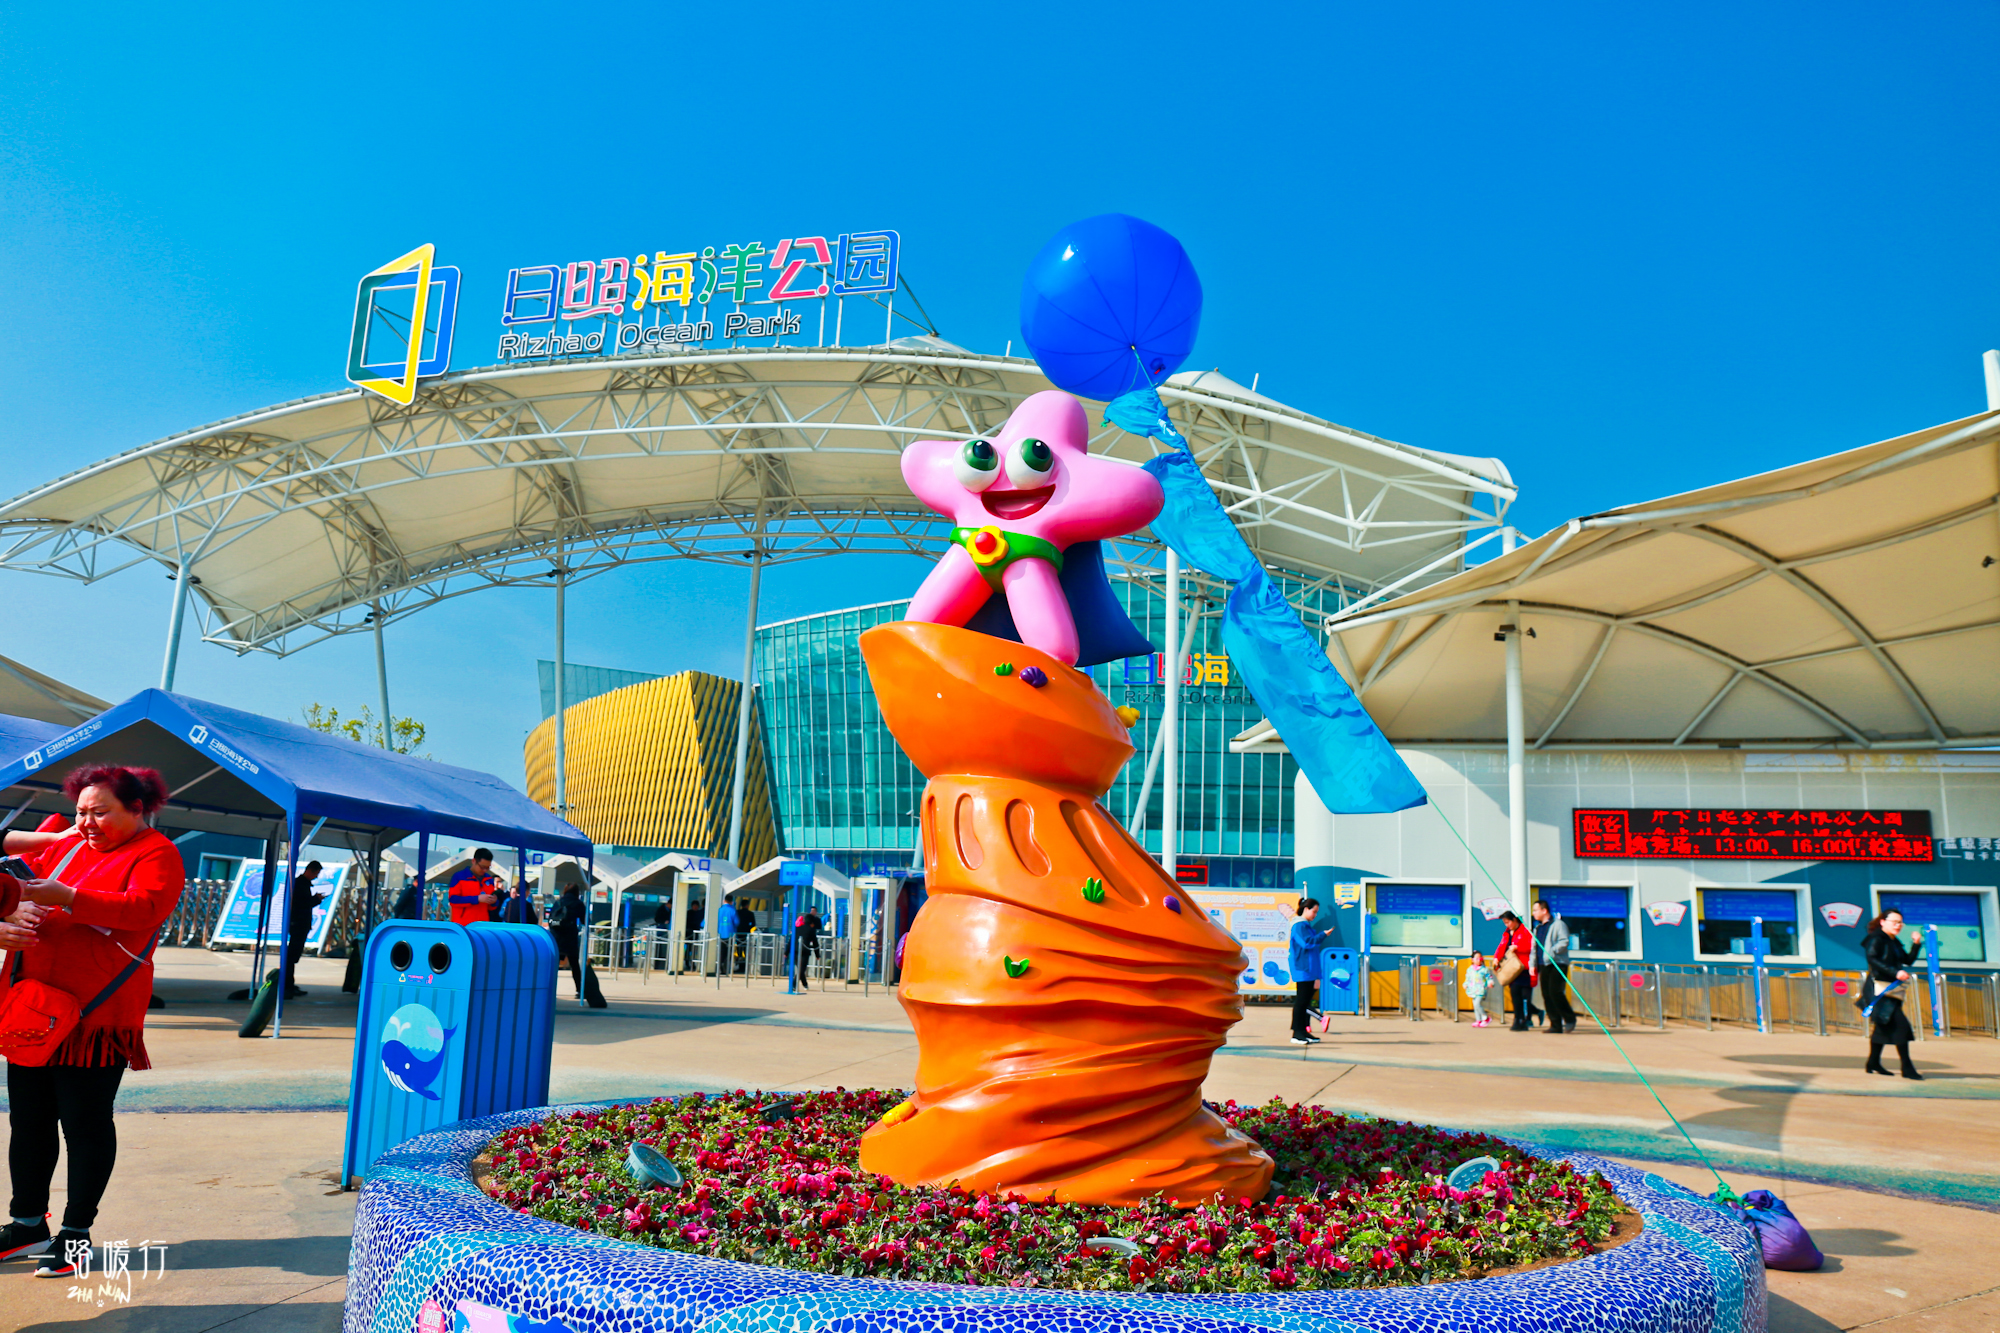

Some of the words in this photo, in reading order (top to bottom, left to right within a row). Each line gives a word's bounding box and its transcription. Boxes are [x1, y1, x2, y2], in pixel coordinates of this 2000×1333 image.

[501, 229, 902, 326] 日照海洋公园
[497, 331, 604, 360] Rizhao
[618, 319, 713, 350] Ocean
[723, 309, 802, 339] Park
[1189, 691, 1248, 705] Ocean
[46, 720, 104, 755] 日照海洋公园
[210, 738, 259, 775] 日照海洋公园
[684, 858, 711, 871] 入口
[858, 862, 888, 875] 入口
